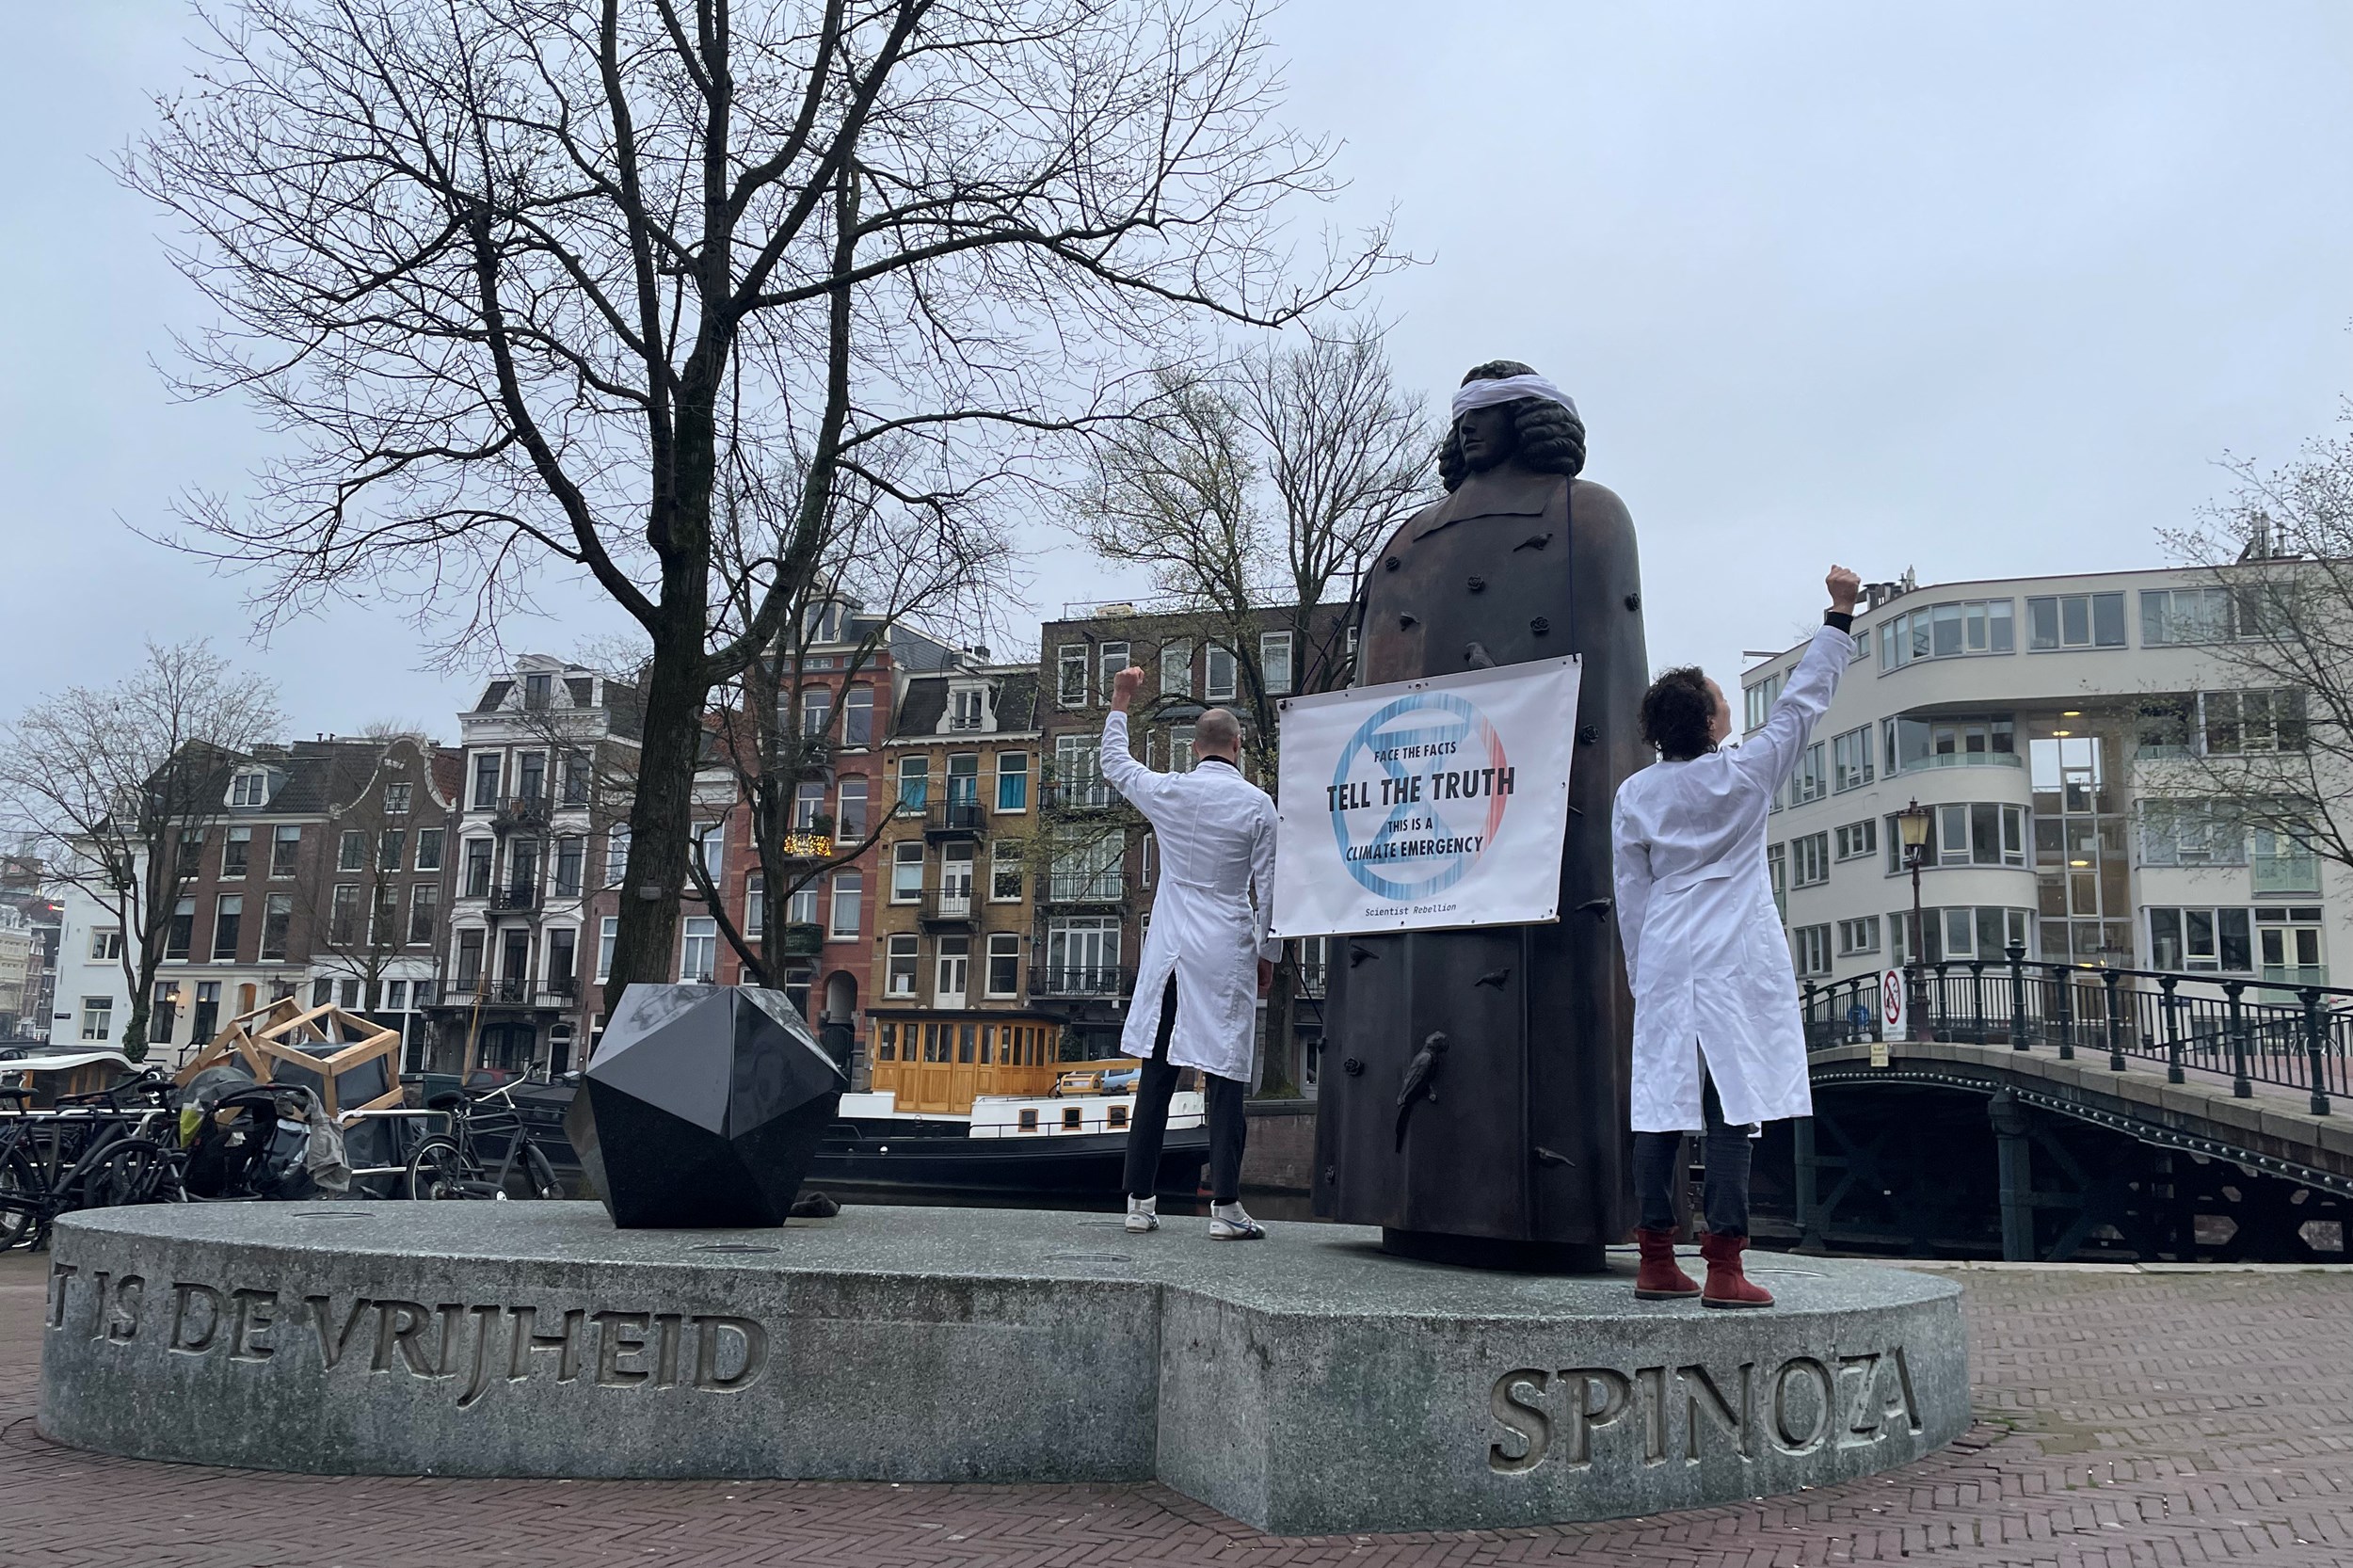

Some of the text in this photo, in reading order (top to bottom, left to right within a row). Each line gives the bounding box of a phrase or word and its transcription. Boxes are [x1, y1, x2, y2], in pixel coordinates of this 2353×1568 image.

[1374, 741, 1457, 763] FACE THE FACTS
[1326, 767, 1515, 812] TELL THE TRUTH
[1387, 817, 1433, 833] THIS IS A
[1346, 836, 1484, 862] CLIMATE EMERGENCY
[1365, 904, 1457, 917] Scientist Rebellion
[91, 1271, 146, 1346] IS
[168, 1282, 279, 1364] DE
[304, 1295, 769, 1409] VRIJHEID
[1489, 1345, 1924, 1475] SPINOZA
